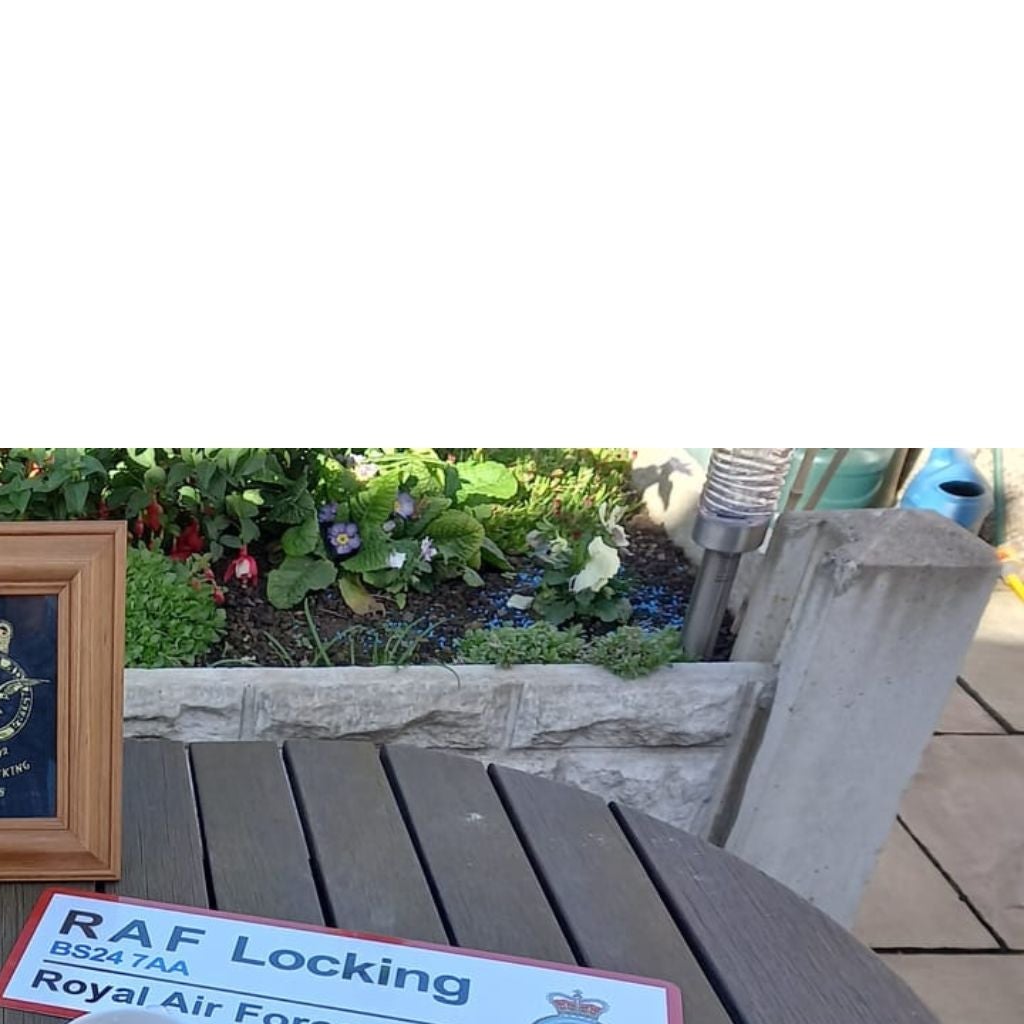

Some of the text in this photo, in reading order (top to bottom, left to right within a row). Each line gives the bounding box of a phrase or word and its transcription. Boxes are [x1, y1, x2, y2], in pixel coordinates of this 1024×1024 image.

[49, 940, 189, 977] BS24 7AA
[59, 910, 471, 1006] RAF Locking
[31, 968, 150, 1007] Royal
[159, 991, 225, 1018] Air
